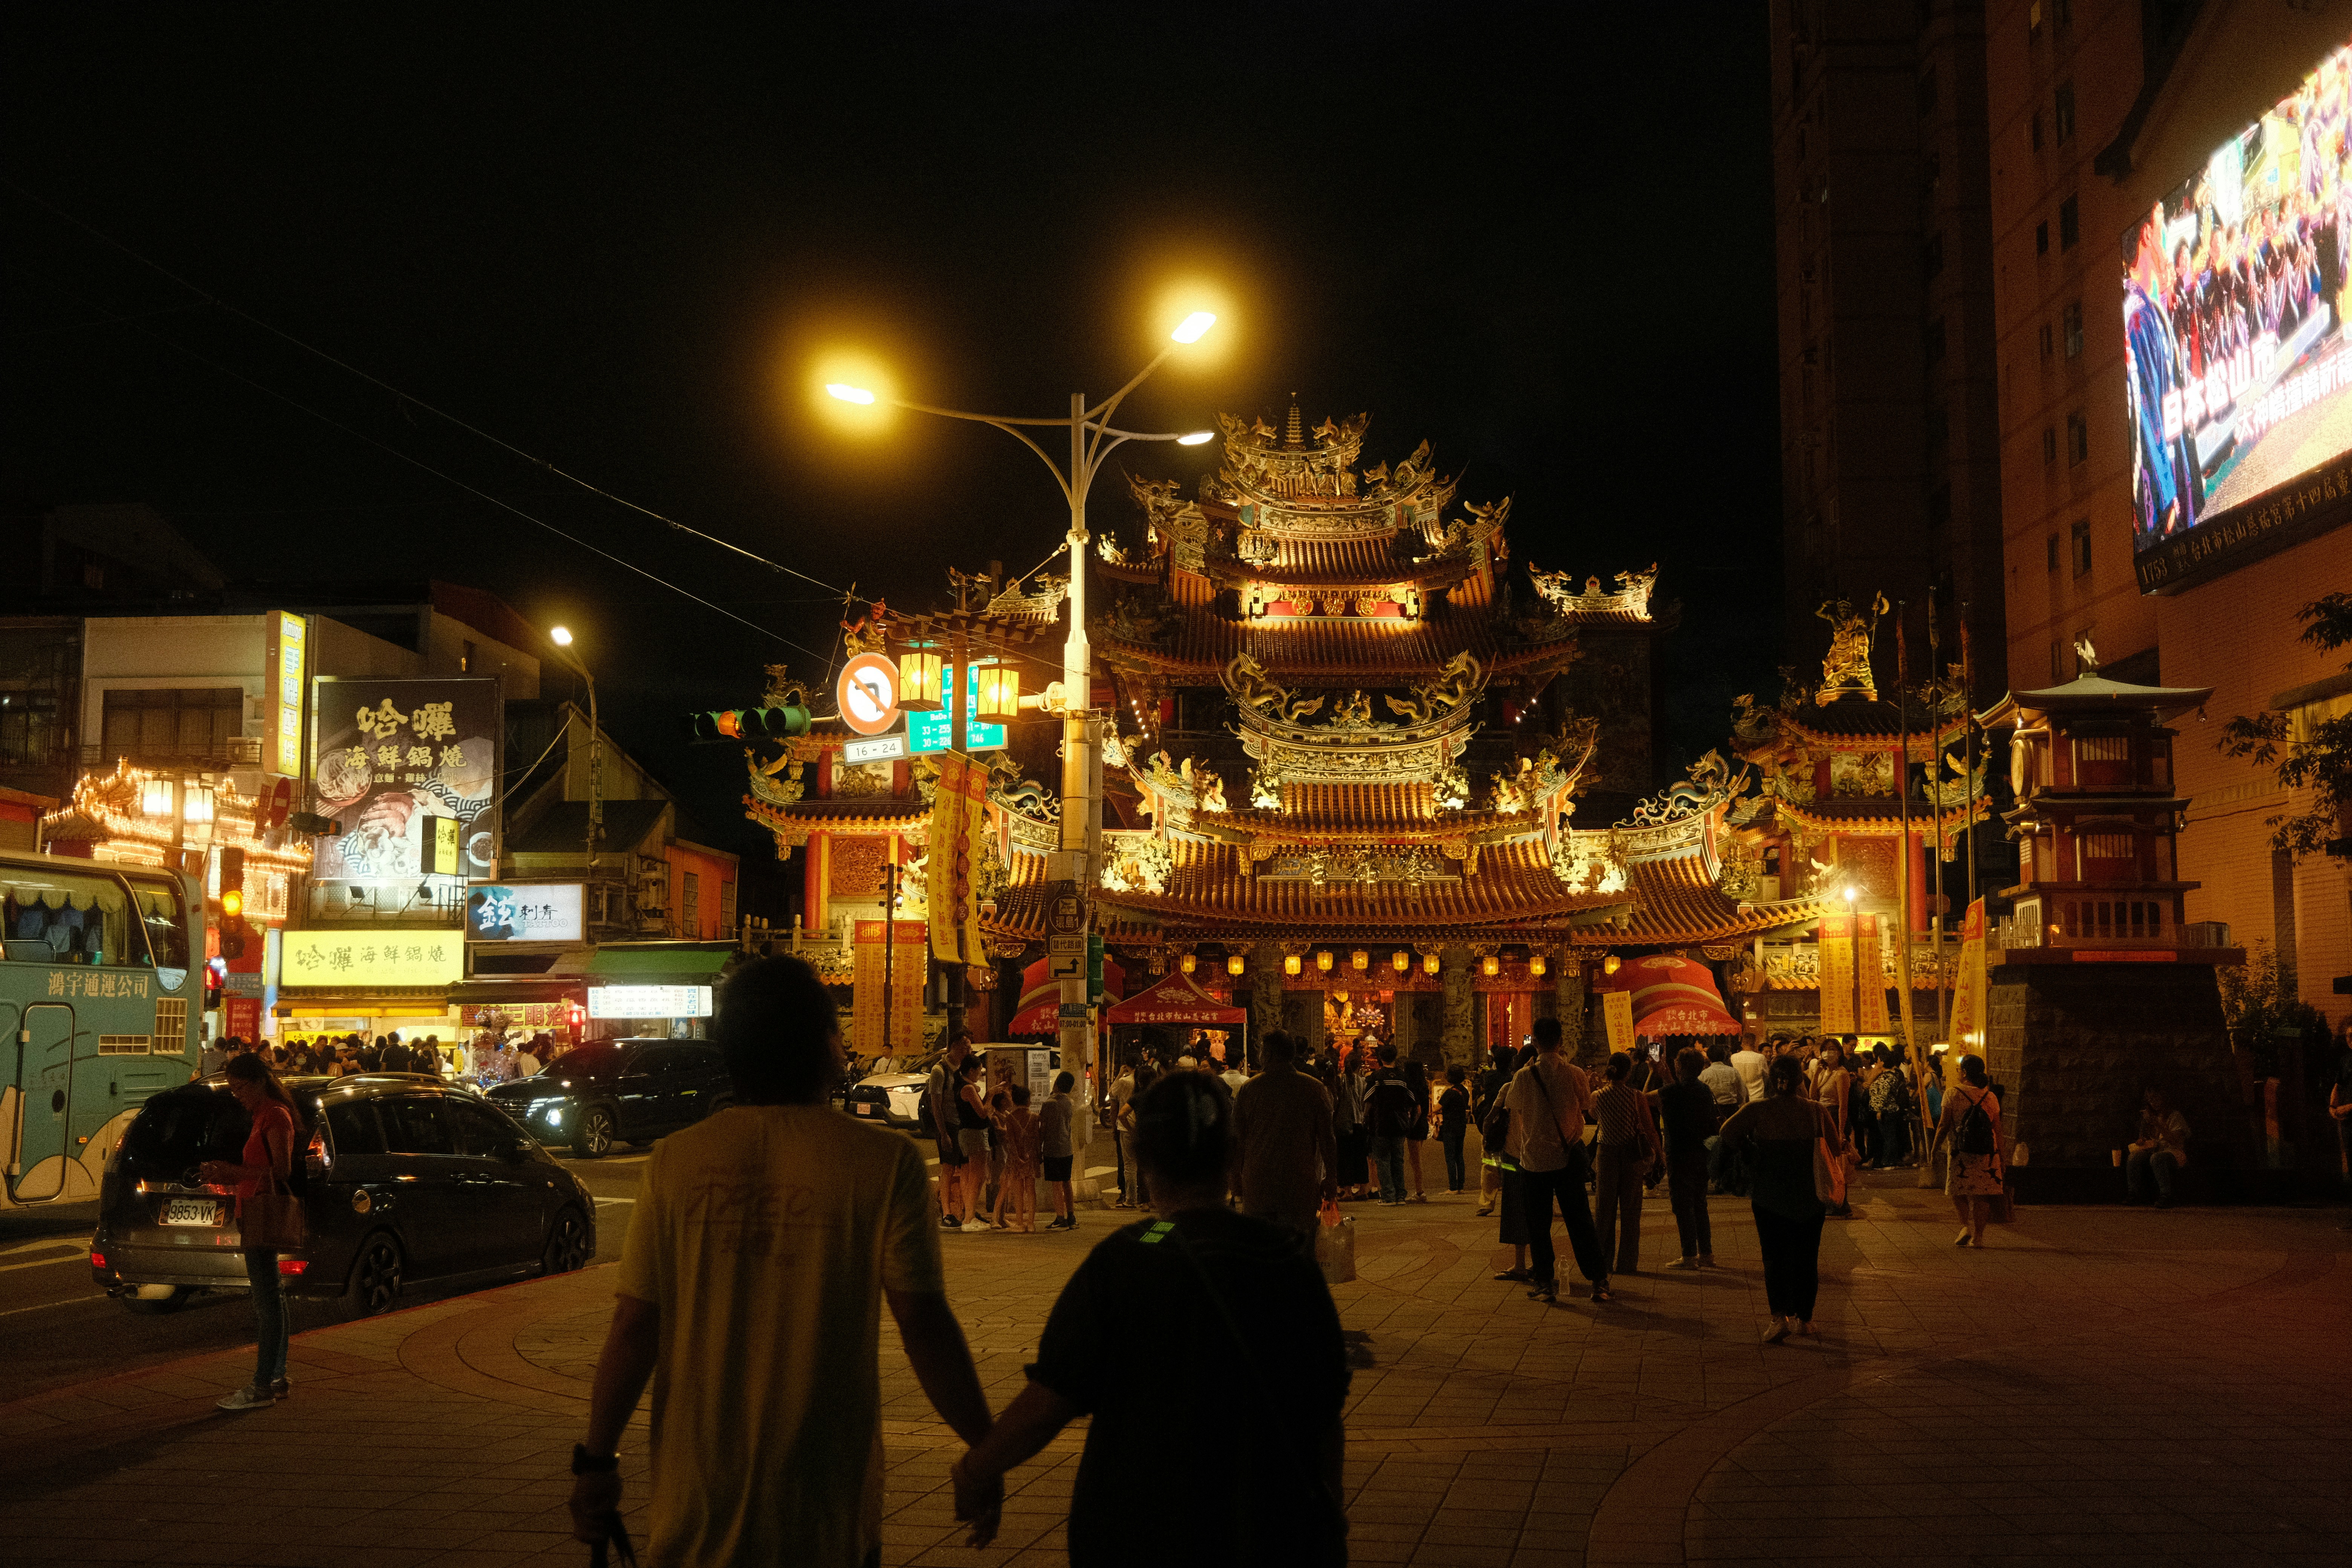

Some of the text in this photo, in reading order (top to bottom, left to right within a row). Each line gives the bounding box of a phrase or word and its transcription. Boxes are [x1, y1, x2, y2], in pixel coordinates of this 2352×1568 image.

[2164, 332, 2276, 439] 日本松山市
[2142, 557, 2167, 584] 1753
[282, 616, 302, 643] Amigo
[282, 645, 300, 767] 手機配件
[357, 698, 456, 741] 哈囉
[922, 726, 931, 735] 33
[856, 746, 868, 756] 16
[882, 743, 896, 753] 24
[923, 738, 931, 747] 30
[345, 744, 467, 771] 海鮮鍋燒
[519, 903, 558, 920] 刺青
[522, 919, 568, 928] TATTOO
[1056, 916, 1079, 928] 環島1
[295, 943, 447, 972] 哈囉 海鮮鍋燒
[48, 971, 149, 998] 鴻宇通運公司
[1031, 1019, 1055, 1031] 松山
[1149, 1012, 1219, 1021] 台北市松山慈祐宮
[169, 1204, 215, 1221] 9853-VK
